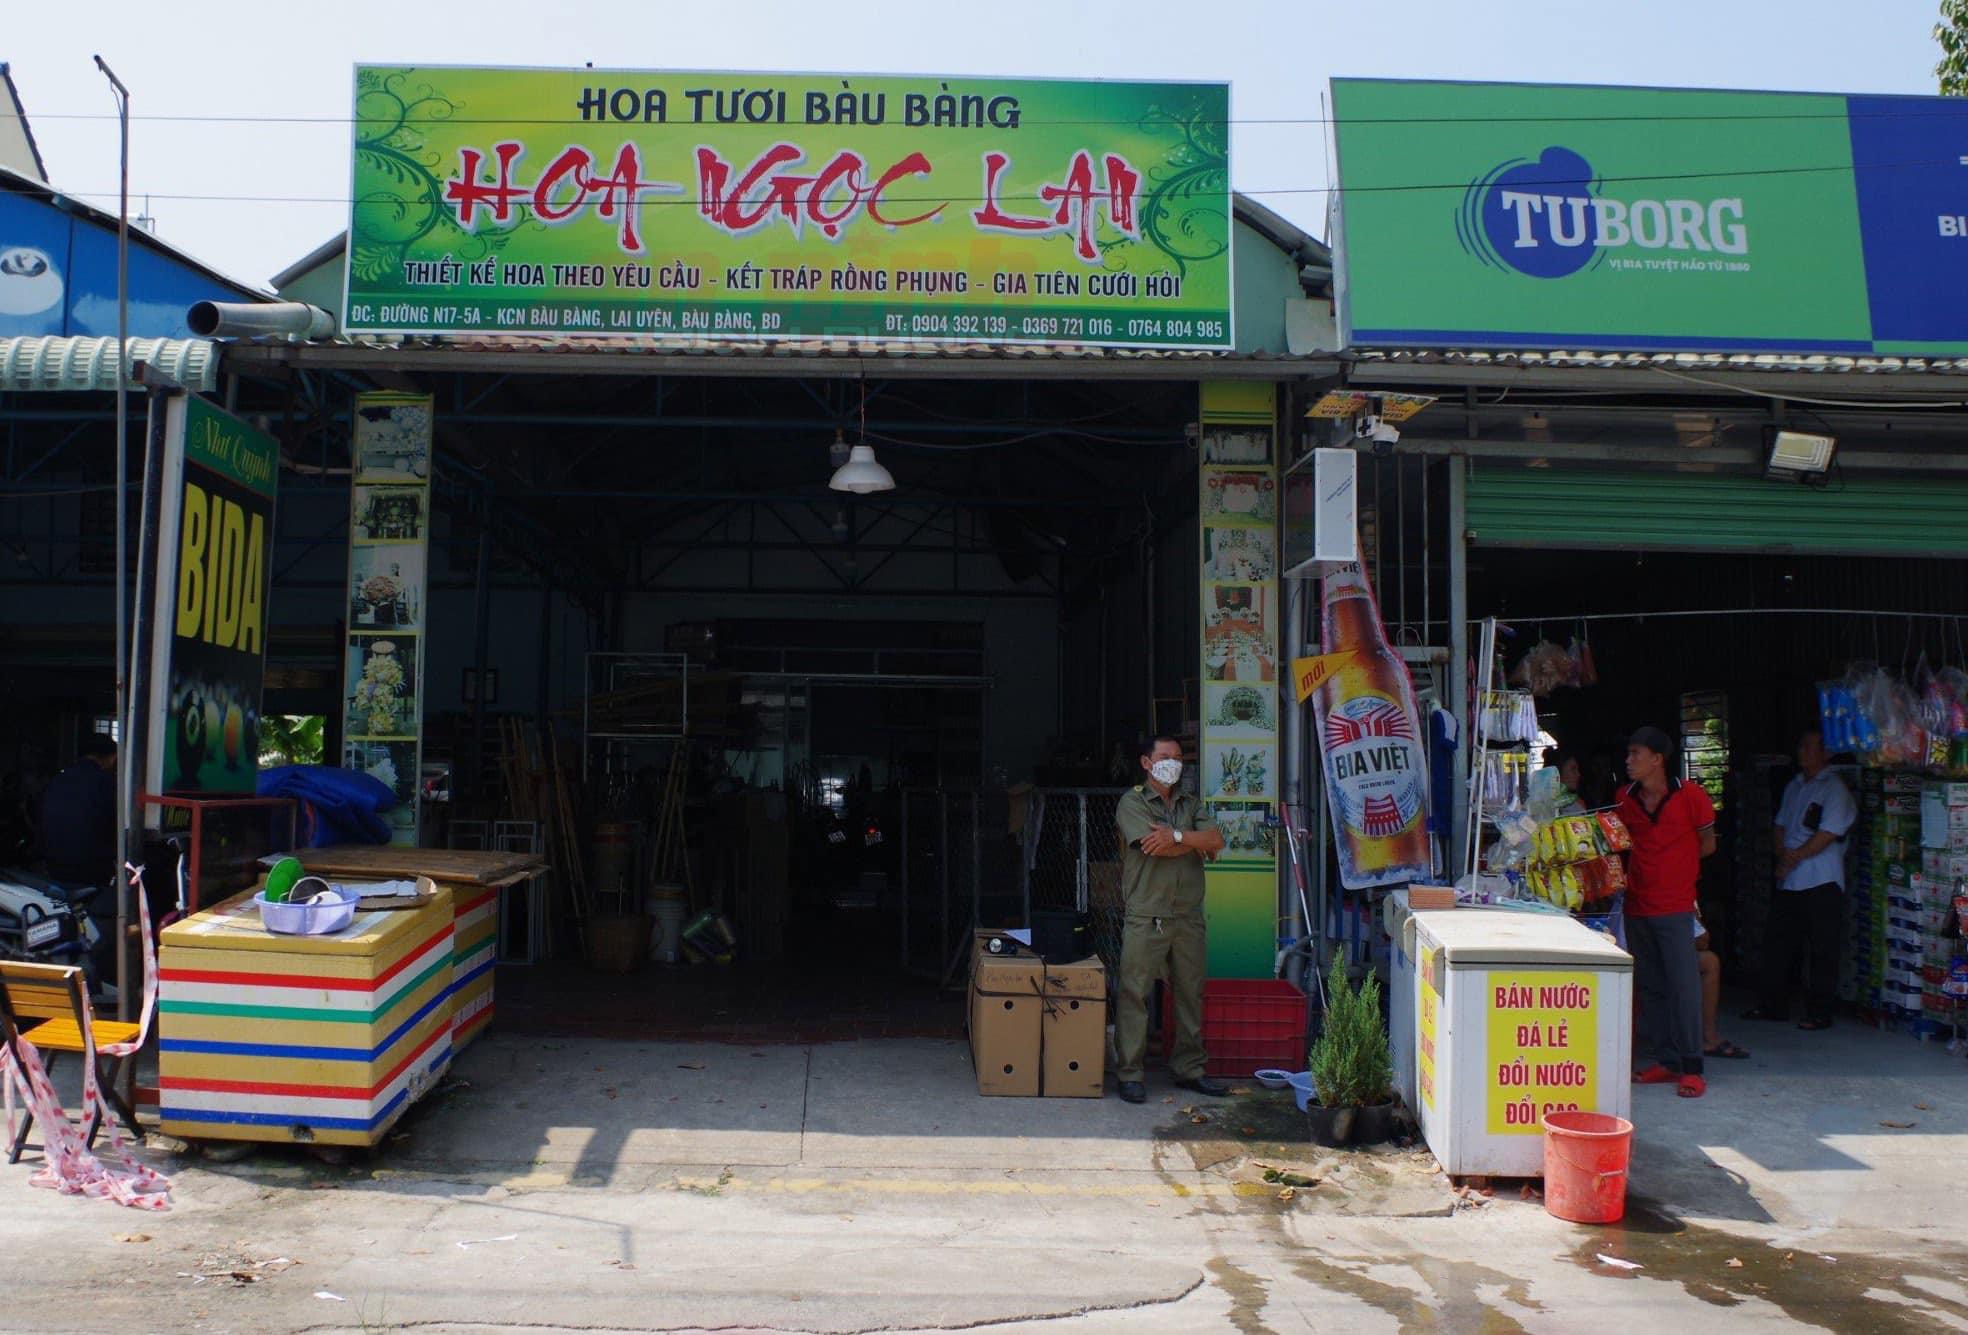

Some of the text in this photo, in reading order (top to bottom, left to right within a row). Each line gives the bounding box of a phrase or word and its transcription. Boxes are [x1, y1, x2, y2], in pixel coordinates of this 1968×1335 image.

[577, 80, 1021, 129] HOA TƯƠI BÀU BÀNG
[446, 143, 1137, 260] HOA NGỌC LAN
[1501, 190, 1749, 255] TUBORG
[405, 255, 462, 285] THIẾT
[471, 256, 497, 285] KẾ
[503, 263, 544, 286] HOA
[553, 264, 605, 287] THEO
[612, 259, 650, 288] YÊU
[659, 258, 700, 289] CẦU
[726, 259, 762, 290] KẾT
[770, 266, 822, 291] TRÁP
[830, 262, 887, 292] RỒNG
[897, 269, 967, 298] PHỤNG
[993, 272, 1026, 295] GIA
[1034, 269, 1080, 296] TIÊN
[1087, 267, 1137, 298] CƯỚI
[1145, 272, 1181, 299] HỎI
[1623, 259, 1642, 270] BIA
[352, 306, 375, 323] ĐC:
[380, 303, 429, 324] ĐƯỜNG
[433, 307, 481, 325] N17-5A
[497, 308, 527, 326] KCN
[531, 305, 559, 327] BÀU
[563, 306, 604, 329] BÀNG,
[611, 309, 632, 327] LAI
[636, 306, 677, 331] UYÊN,
[682, 306, 709, 329] BÀU
[713, 308, 757, 333] BÀNG,
[762, 312, 781, 330] BD
[886, 313, 908, 332] ĐT:
[912, 315, 949, 332] 0904
[953, 315, 979, 333] 392
[982, 316, 1006, 333] 139
[1023, 317, 1058, 334] 0369
[1061, 318, 1084, 335] 721
[1088, 318, 1112, 336] 016
[1128, 319, 1163, 337] 0764
[1166, 320, 1192, 338] 804
[1197, 321, 1222, 339] 985
[176, 482, 264, 656] BIDA
[1336, 742, 1411, 782] BIA VIỆT
[1495, 982, 1590, 1009] BÁN NƯỚC
[1517, 1018, 1568, 1048] ĐÁ LẺ
[1498, 1055, 1586, 1086] ĐỔI NƯỚC
[1506, 1093, 1537, 1125] ĐỔI
